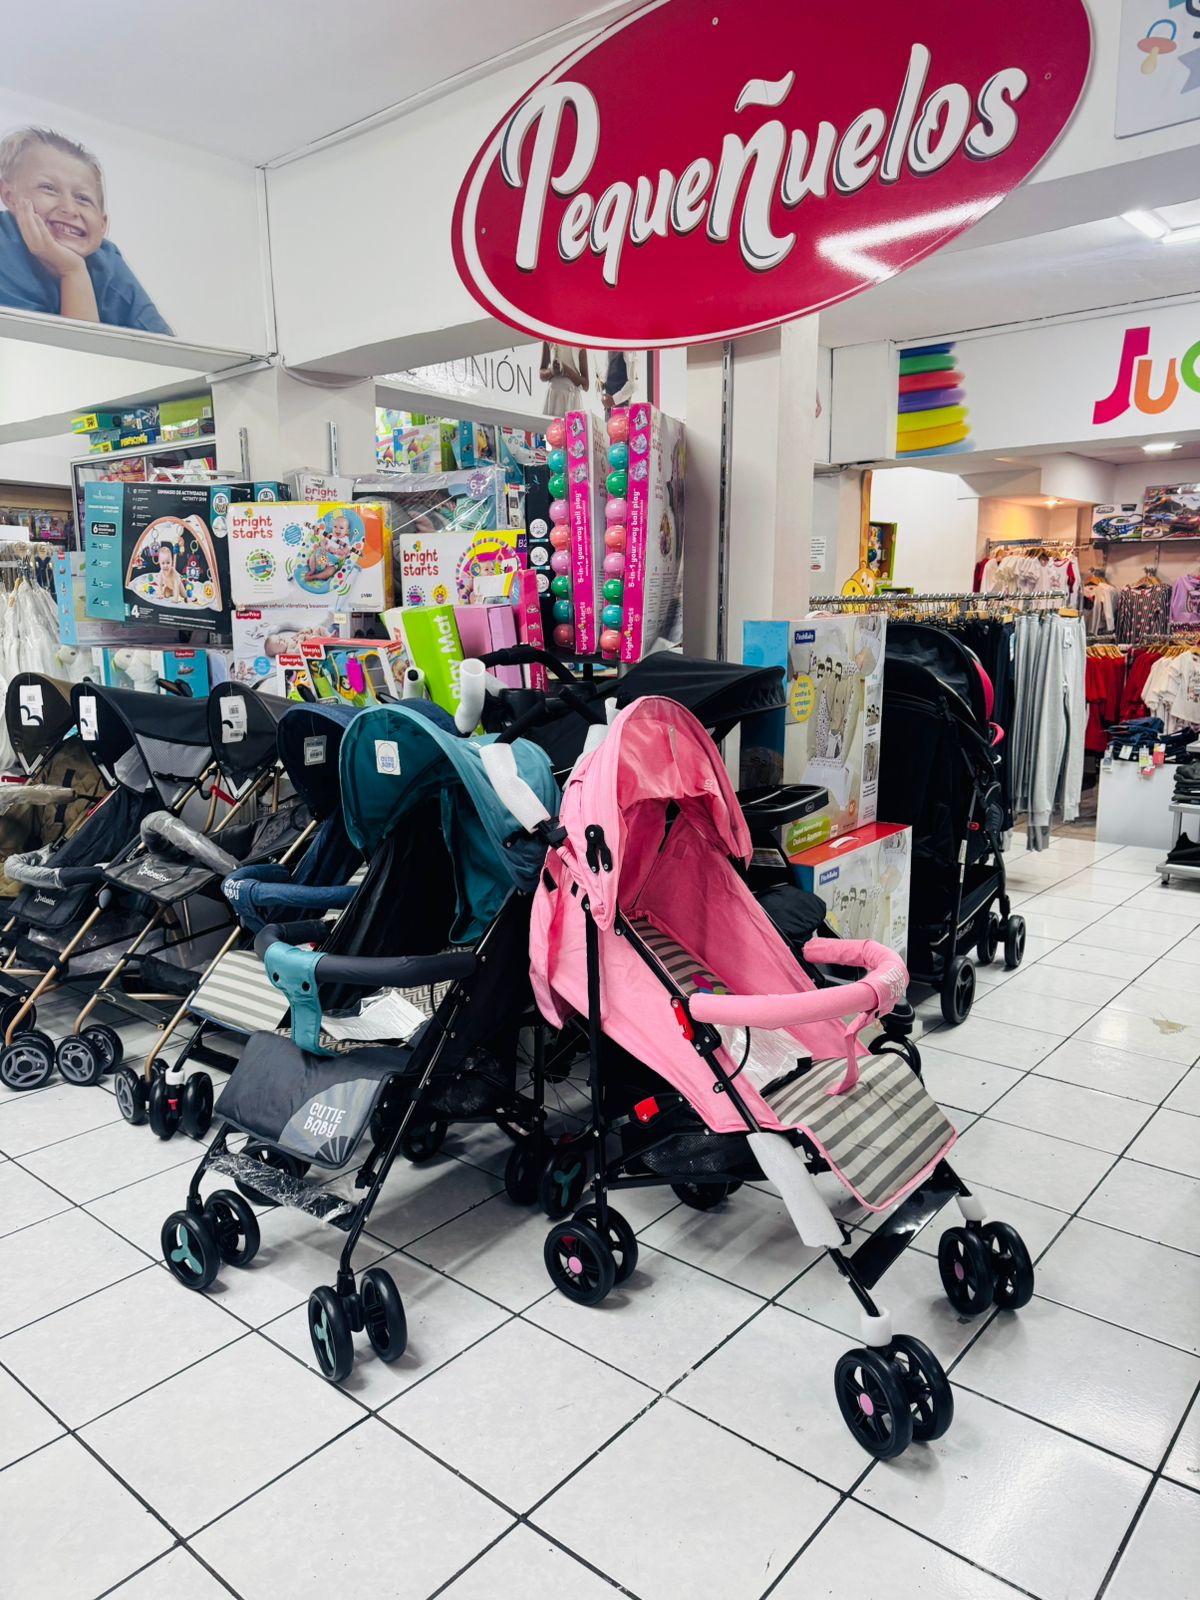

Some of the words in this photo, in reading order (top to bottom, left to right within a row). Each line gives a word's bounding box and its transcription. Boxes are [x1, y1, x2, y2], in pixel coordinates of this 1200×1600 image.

[500, 43, 1028, 287] Pequeñuelos
[305, 485, 338, 498] bright
[233, 516, 273, 530] bright
[233, 529, 273, 539] starts
[403, 550, 438, 565] bright
[577, 544, 585, 560] your
[404, 564, 439, 576] starts
[433, 615, 457, 654] Mat
[309, 1102, 347, 1124] CUTIE
[303, 1116, 338, 1138] BABY
